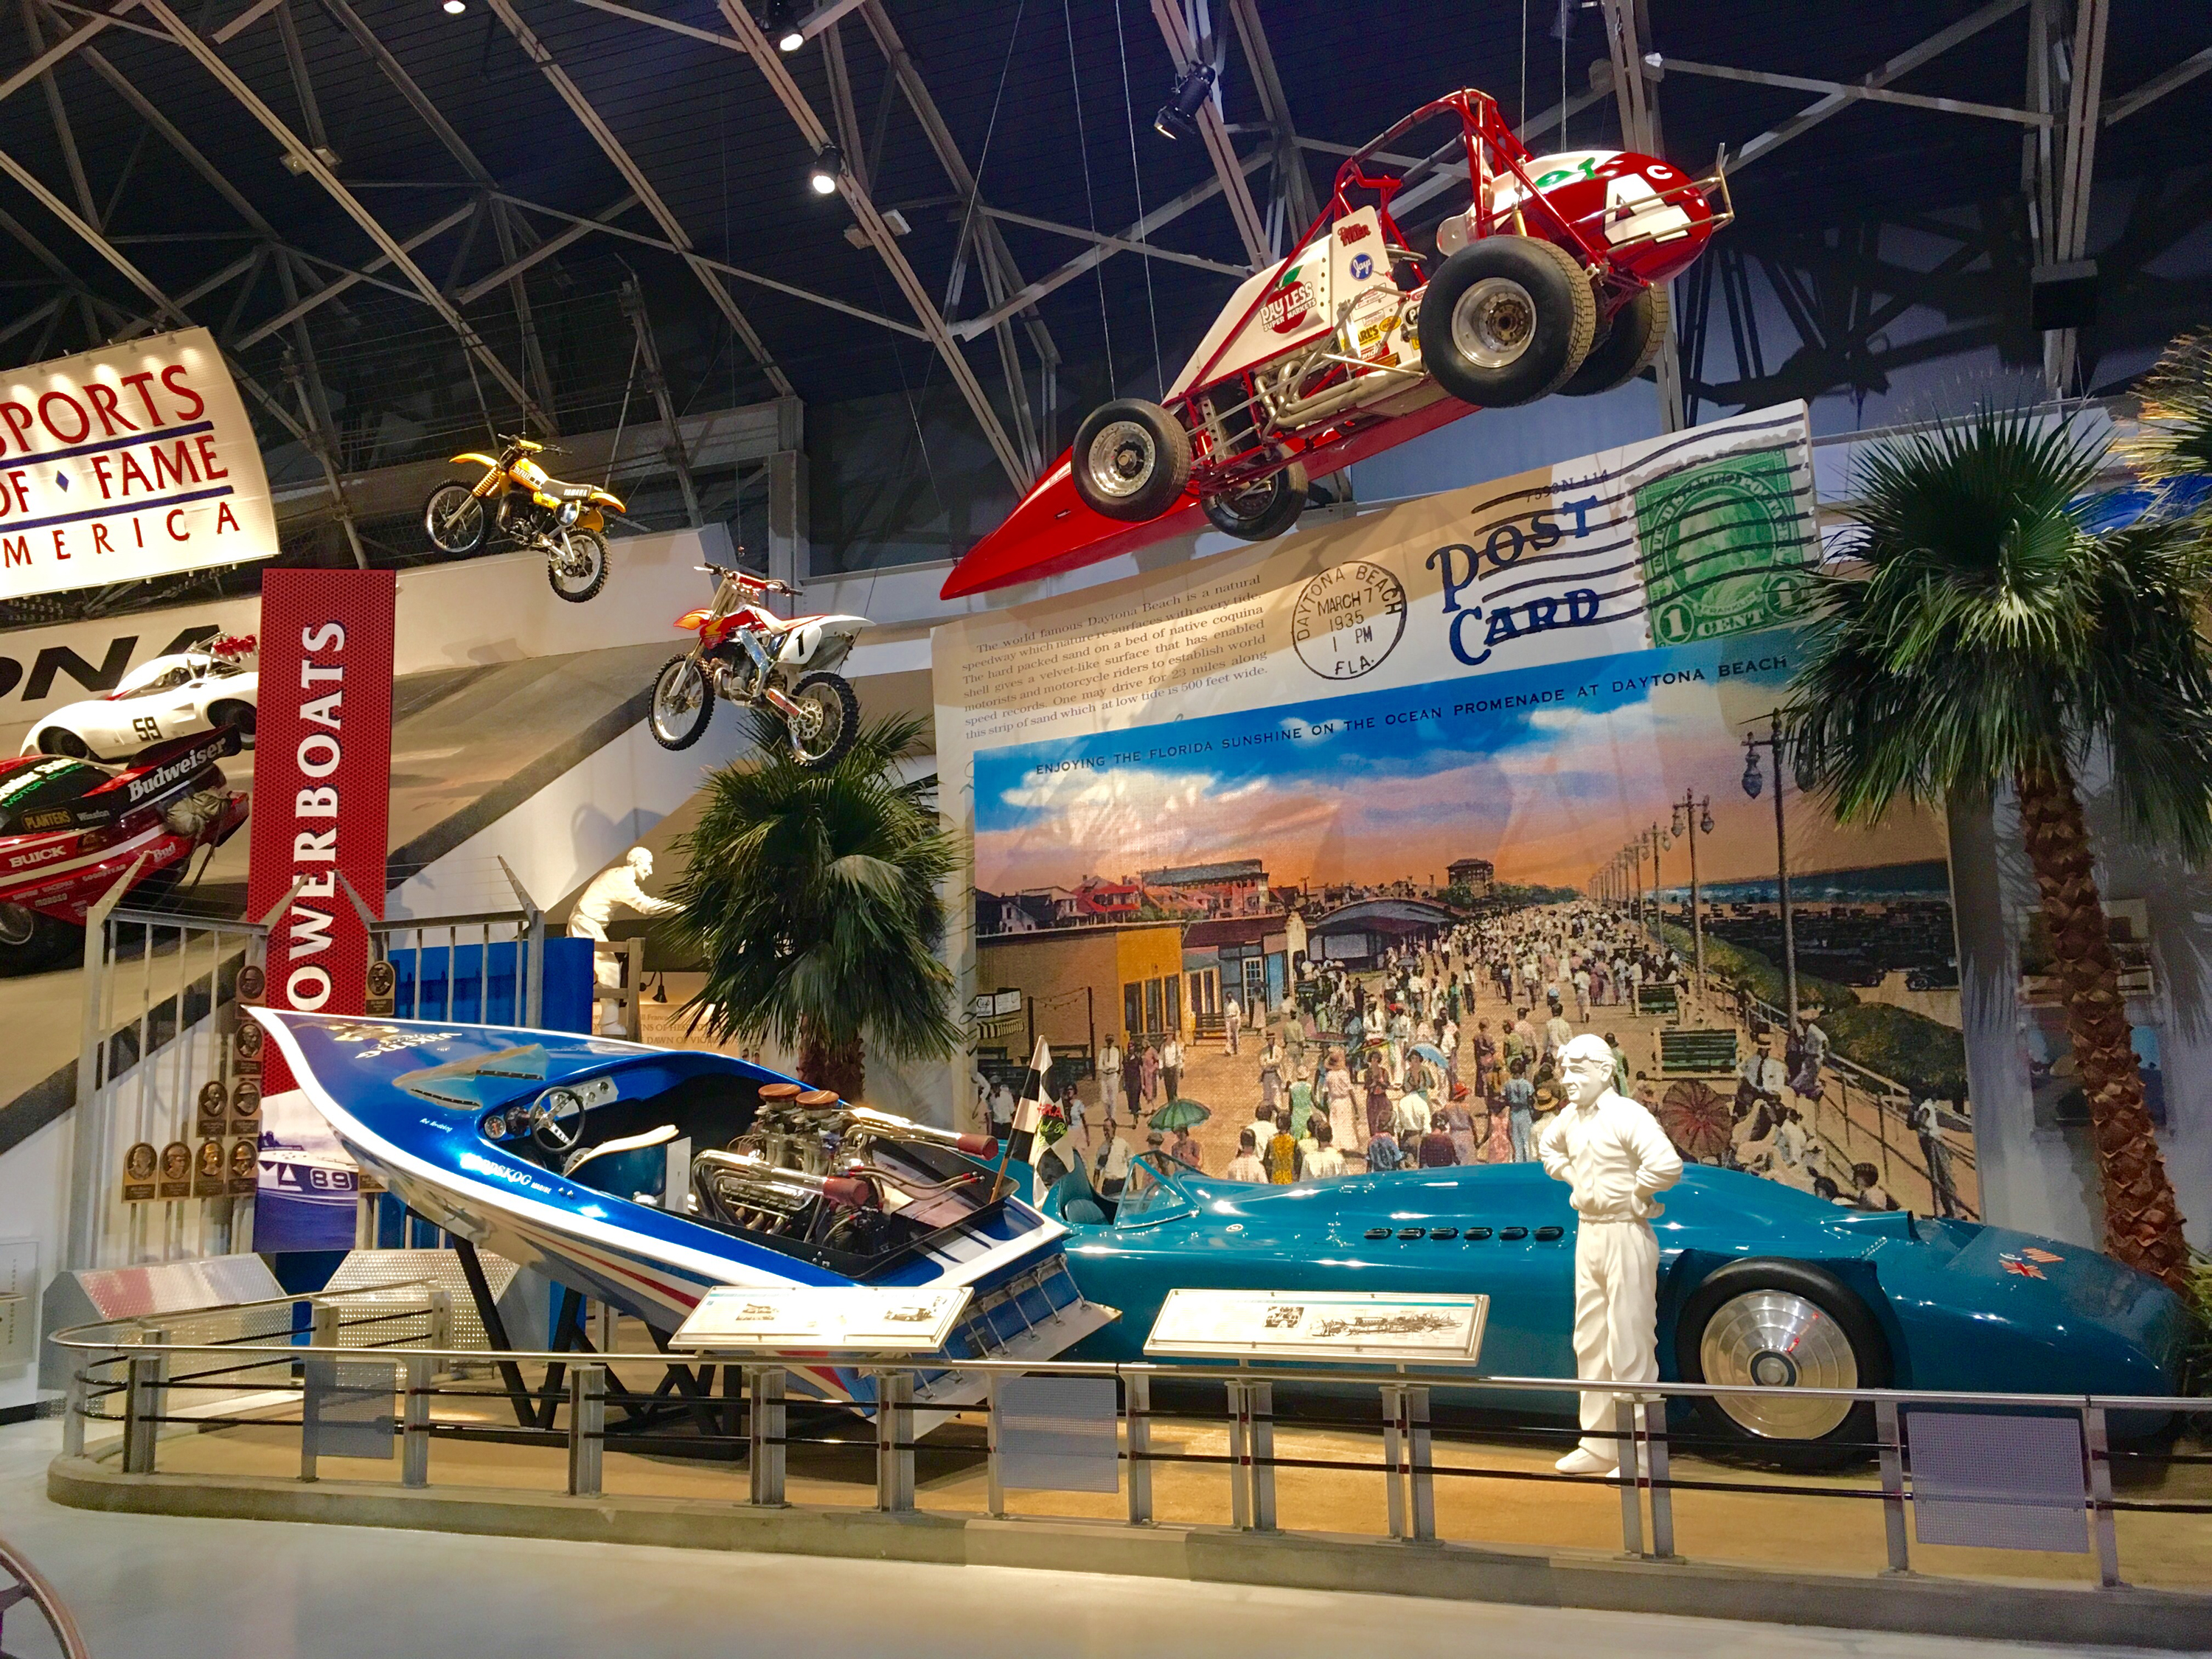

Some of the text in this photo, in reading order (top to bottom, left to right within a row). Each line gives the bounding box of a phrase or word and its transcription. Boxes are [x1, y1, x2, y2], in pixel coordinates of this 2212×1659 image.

[1340, 224, 1371, 247] TYLER
[1284, 282, 1315, 313] LESS
[1263, 297, 1317, 333] SUPER MARKETS
[90, 435, 228, 499] FAME
[563, 489, 588, 497] YAMAHA
[1427, 495, 1598, 613] POST
[976, 643, 998, 653] The
[1003, 632, 1034, 647] world
[1040, 622, 1082, 638] famous
[1088, 609, 1137, 627] Daytona
[1143, 596, 1180, 612] Beach
[1187, 593, 1197, 602] is
[1215, 575, 1260, 594] natural
[1296, 565, 1402, 641] DAYTONA BEACH
[1317, 588, 1373, 616] MARCH 7
[1703, 594, 1755, 614] FRANKLIN
[962, 592, 1262, 672] speedway which nature re-surfaces with every tide.
[1329, 610, 1365, 632] 1935
[1355, 625, 1373, 644] PM
[1449, 588, 1601, 665] CARD
[1697, 609, 1764, 637] CENT
[795, 629, 805, 658] 1
[963, 607, 1263, 684] The hard packed sand on a bed of native coquina
[964, 685, 989, 698] shell
[995, 679, 1023, 693] gives
[1040, 659, 1099, 681] velvet-like
[1105, 648, 1150, 665] surface
[1155, 641, 1180, 653] that
[1186, 634, 1207, 647] has
[1214, 619, 1265, 639] enabled
[964, 634, 1265, 712] motorists and motorcycle riders to establish world
[1335, 655, 1374, 675] FLA.
[965, 650, 1267, 726] speed records. One may drive for 23 miles along
[966, 667, 1267, 740] this strip of sand which at low tide is 500 feet wide.
[1036, 655, 1788, 775] ENJOYING THE FLORIDA SUNSHINE ON THE OCEAN PROMENADE AT DAYTONA BEACH
[132, 716, 163, 742] 59
[128, 737, 226, 803] Budweiser
[1, 781, 46, 808] MOTOR
[24, 810, 72, 830] PLANTERS
[77, 810, 110, 821] Winston
[286, 621, 346, 1012] OWERBOATS
[9, 846, 66, 868] BUICK
[152, 841, 176, 862] Bud
[647, 1036, 674, 1045] DAWN
[310, 1168, 351, 1192] 89
